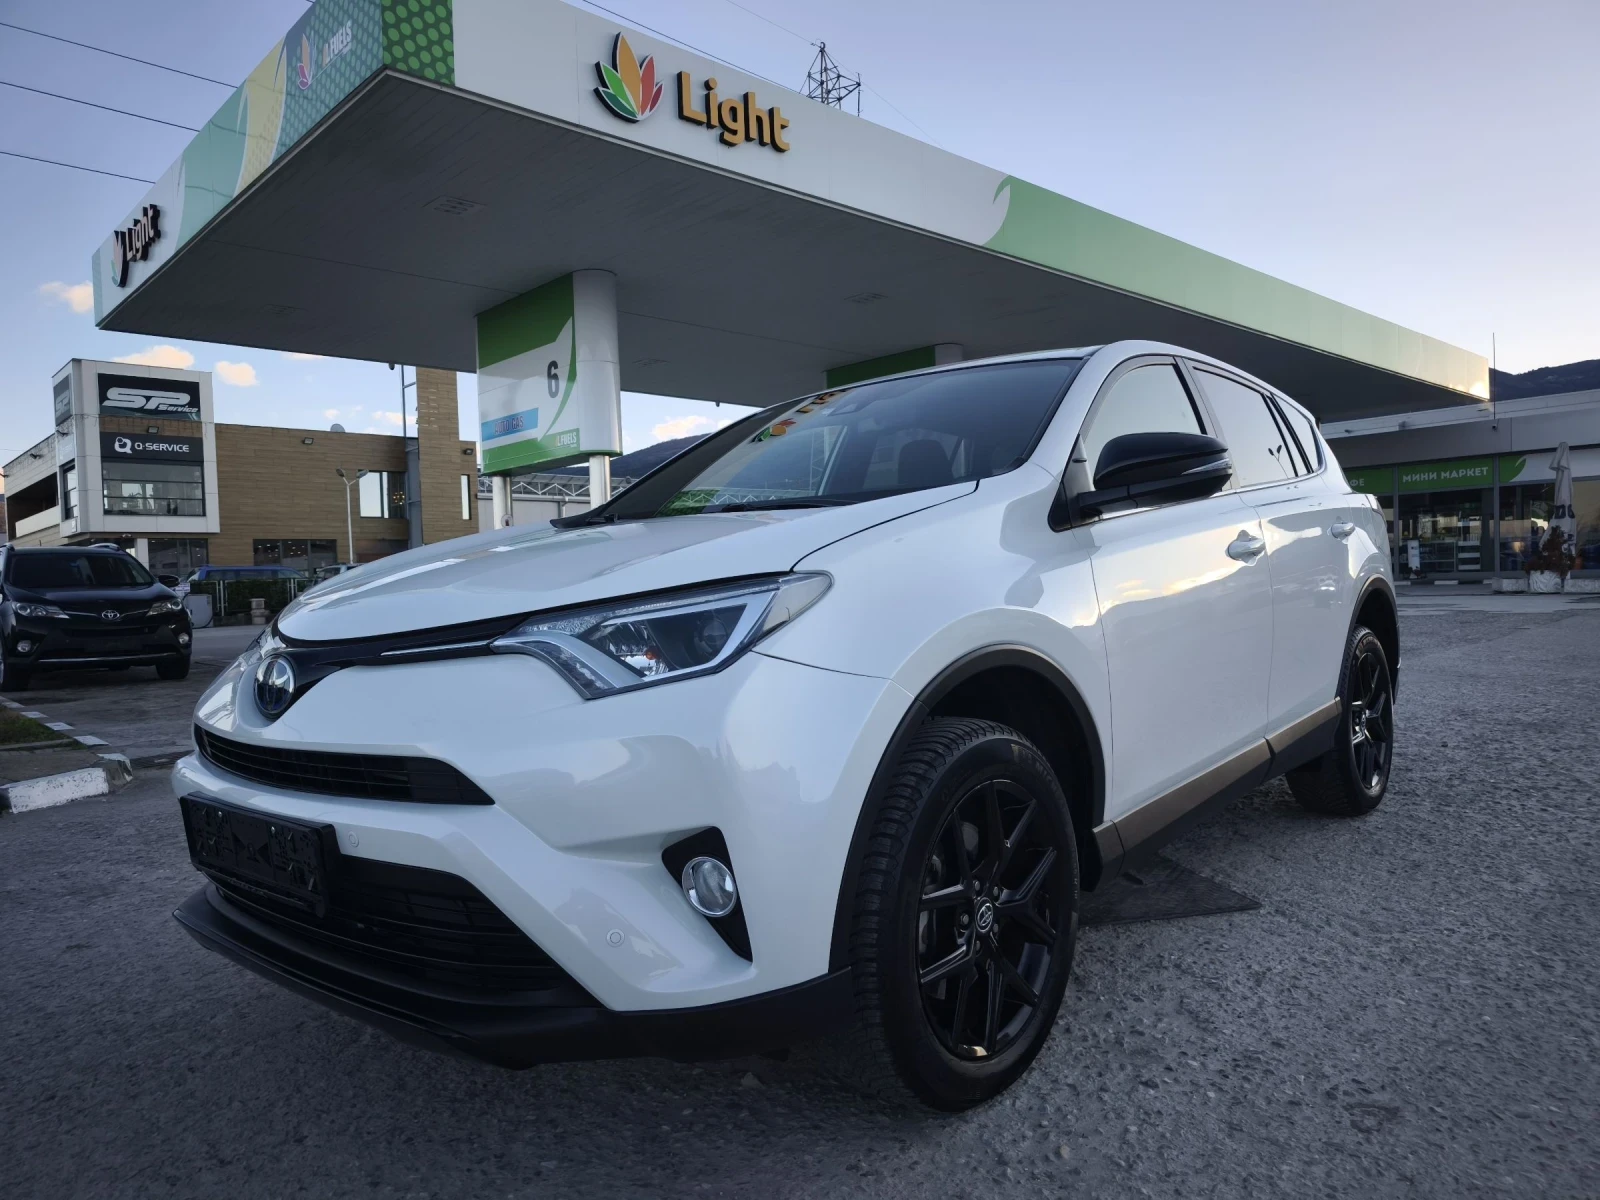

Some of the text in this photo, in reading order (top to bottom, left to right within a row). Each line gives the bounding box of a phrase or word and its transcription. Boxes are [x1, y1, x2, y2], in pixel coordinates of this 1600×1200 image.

[677, 71, 790, 152] Light
[126, 204, 159, 262] Light
[546, 360, 560, 398] 6
[158, 405, 199, 413] Service
[494, 415, 524, 435] AUTO GAS
[1402, 466, 1489, 483] МИНИ МАРКЕТ
